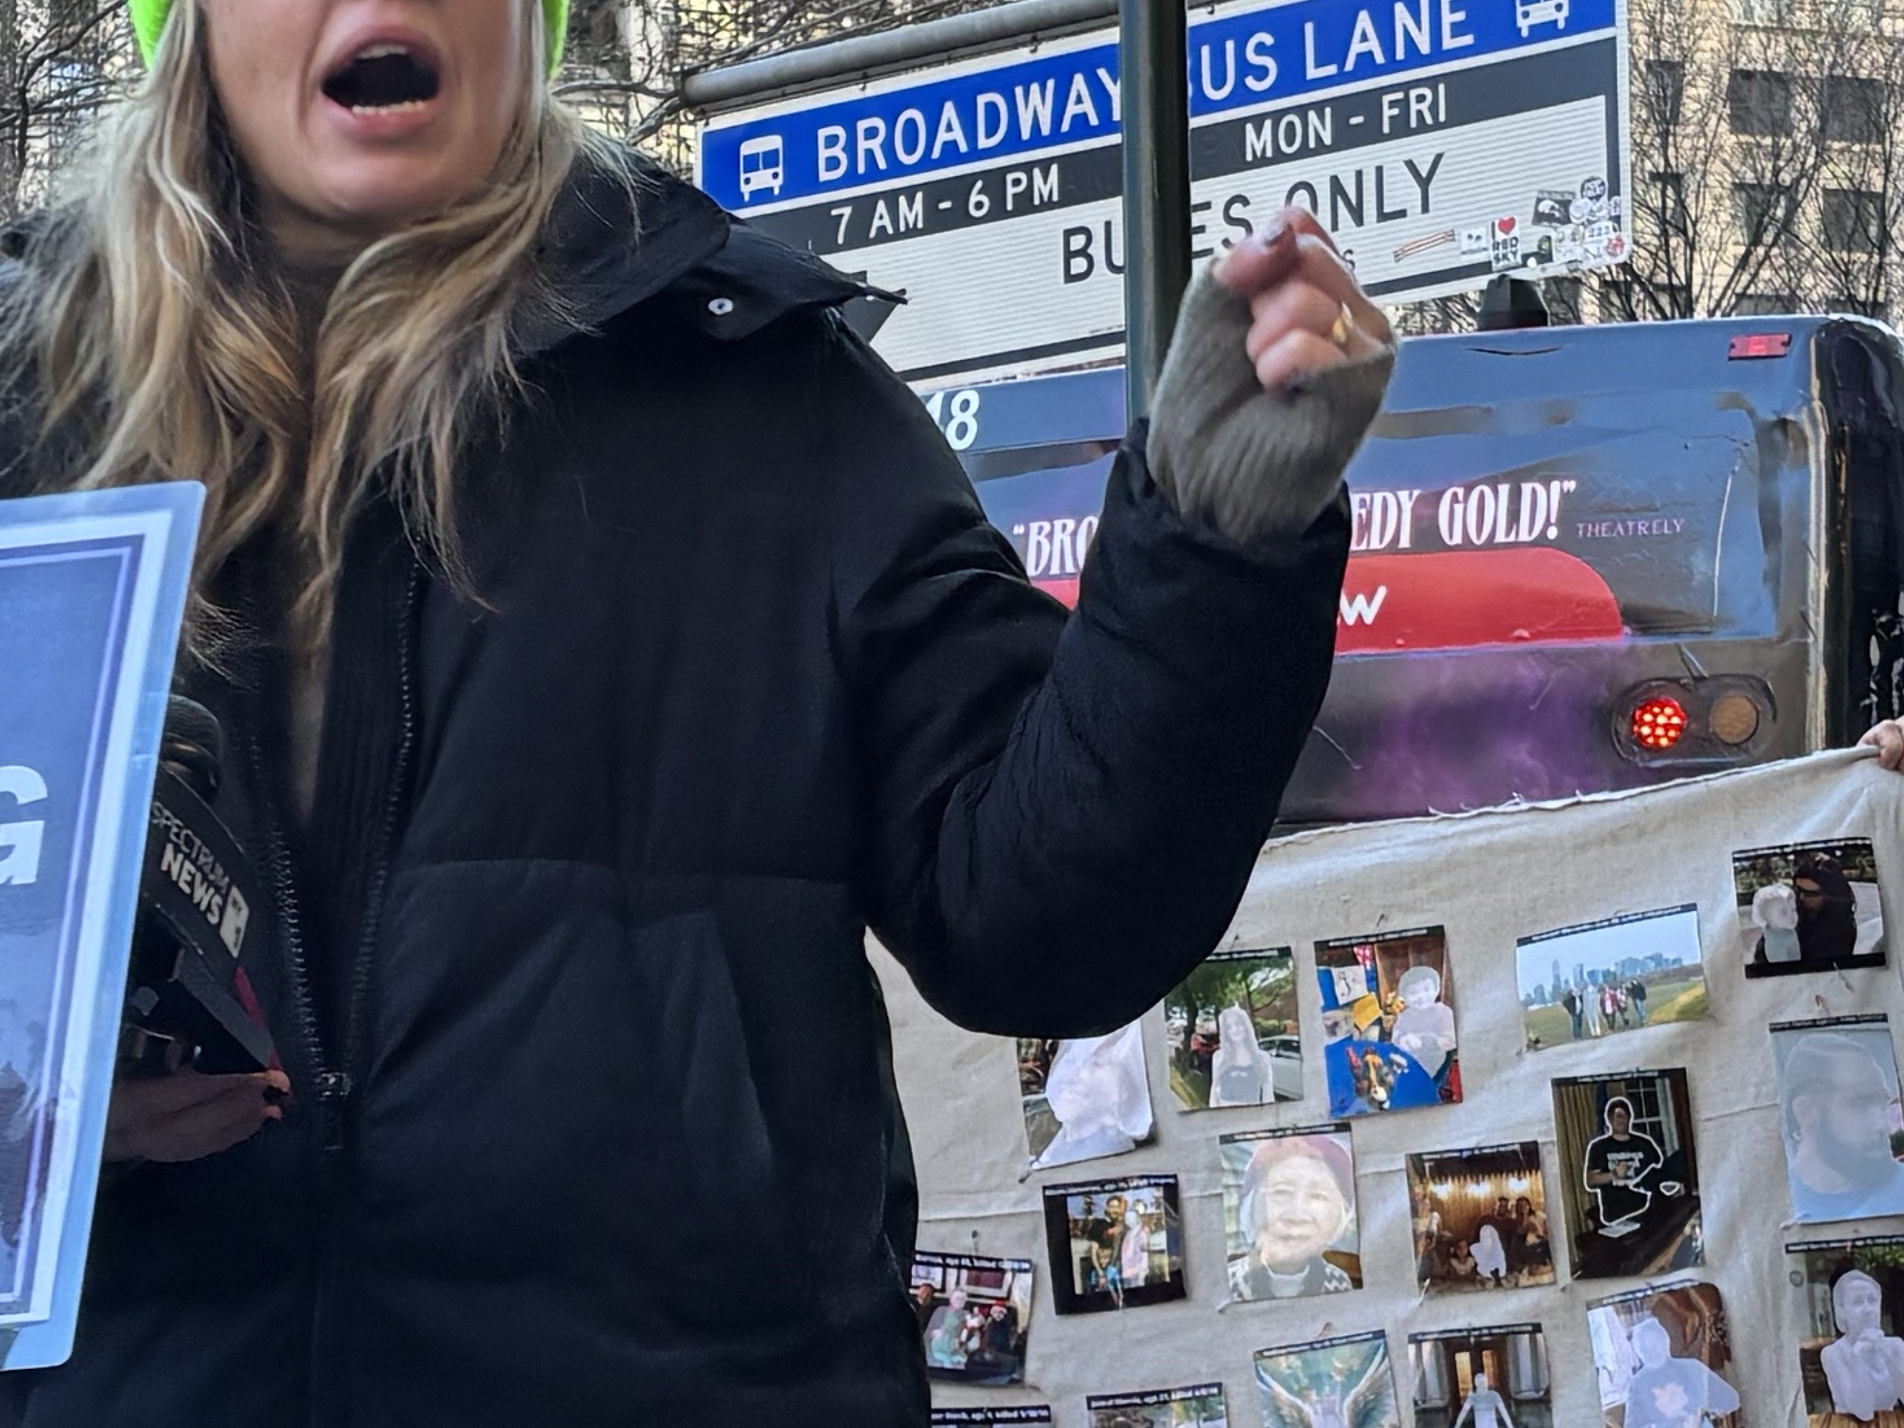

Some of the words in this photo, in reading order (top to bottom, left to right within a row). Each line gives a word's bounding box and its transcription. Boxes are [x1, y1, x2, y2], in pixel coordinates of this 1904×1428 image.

[817, 65, 1123, 183] BROADWAY
[1188, 32, 1278, 101] US
[830, 206, 854, 245] 7
[868, 189, 925, 233] AM
[967, 179, 991, 218] 6
[1004, 164, 1061, 209] PM
[1245, 106, 1333, 161] MON
[1381, 83, 1447, 134] FRI
[1062, 193, 1254, 285] BUES
[1576, 518, 1686, 538] THEATRELY
[152, 801, 231, 895] SPECTRUM
[160, 842, 223, 926] NEWS
